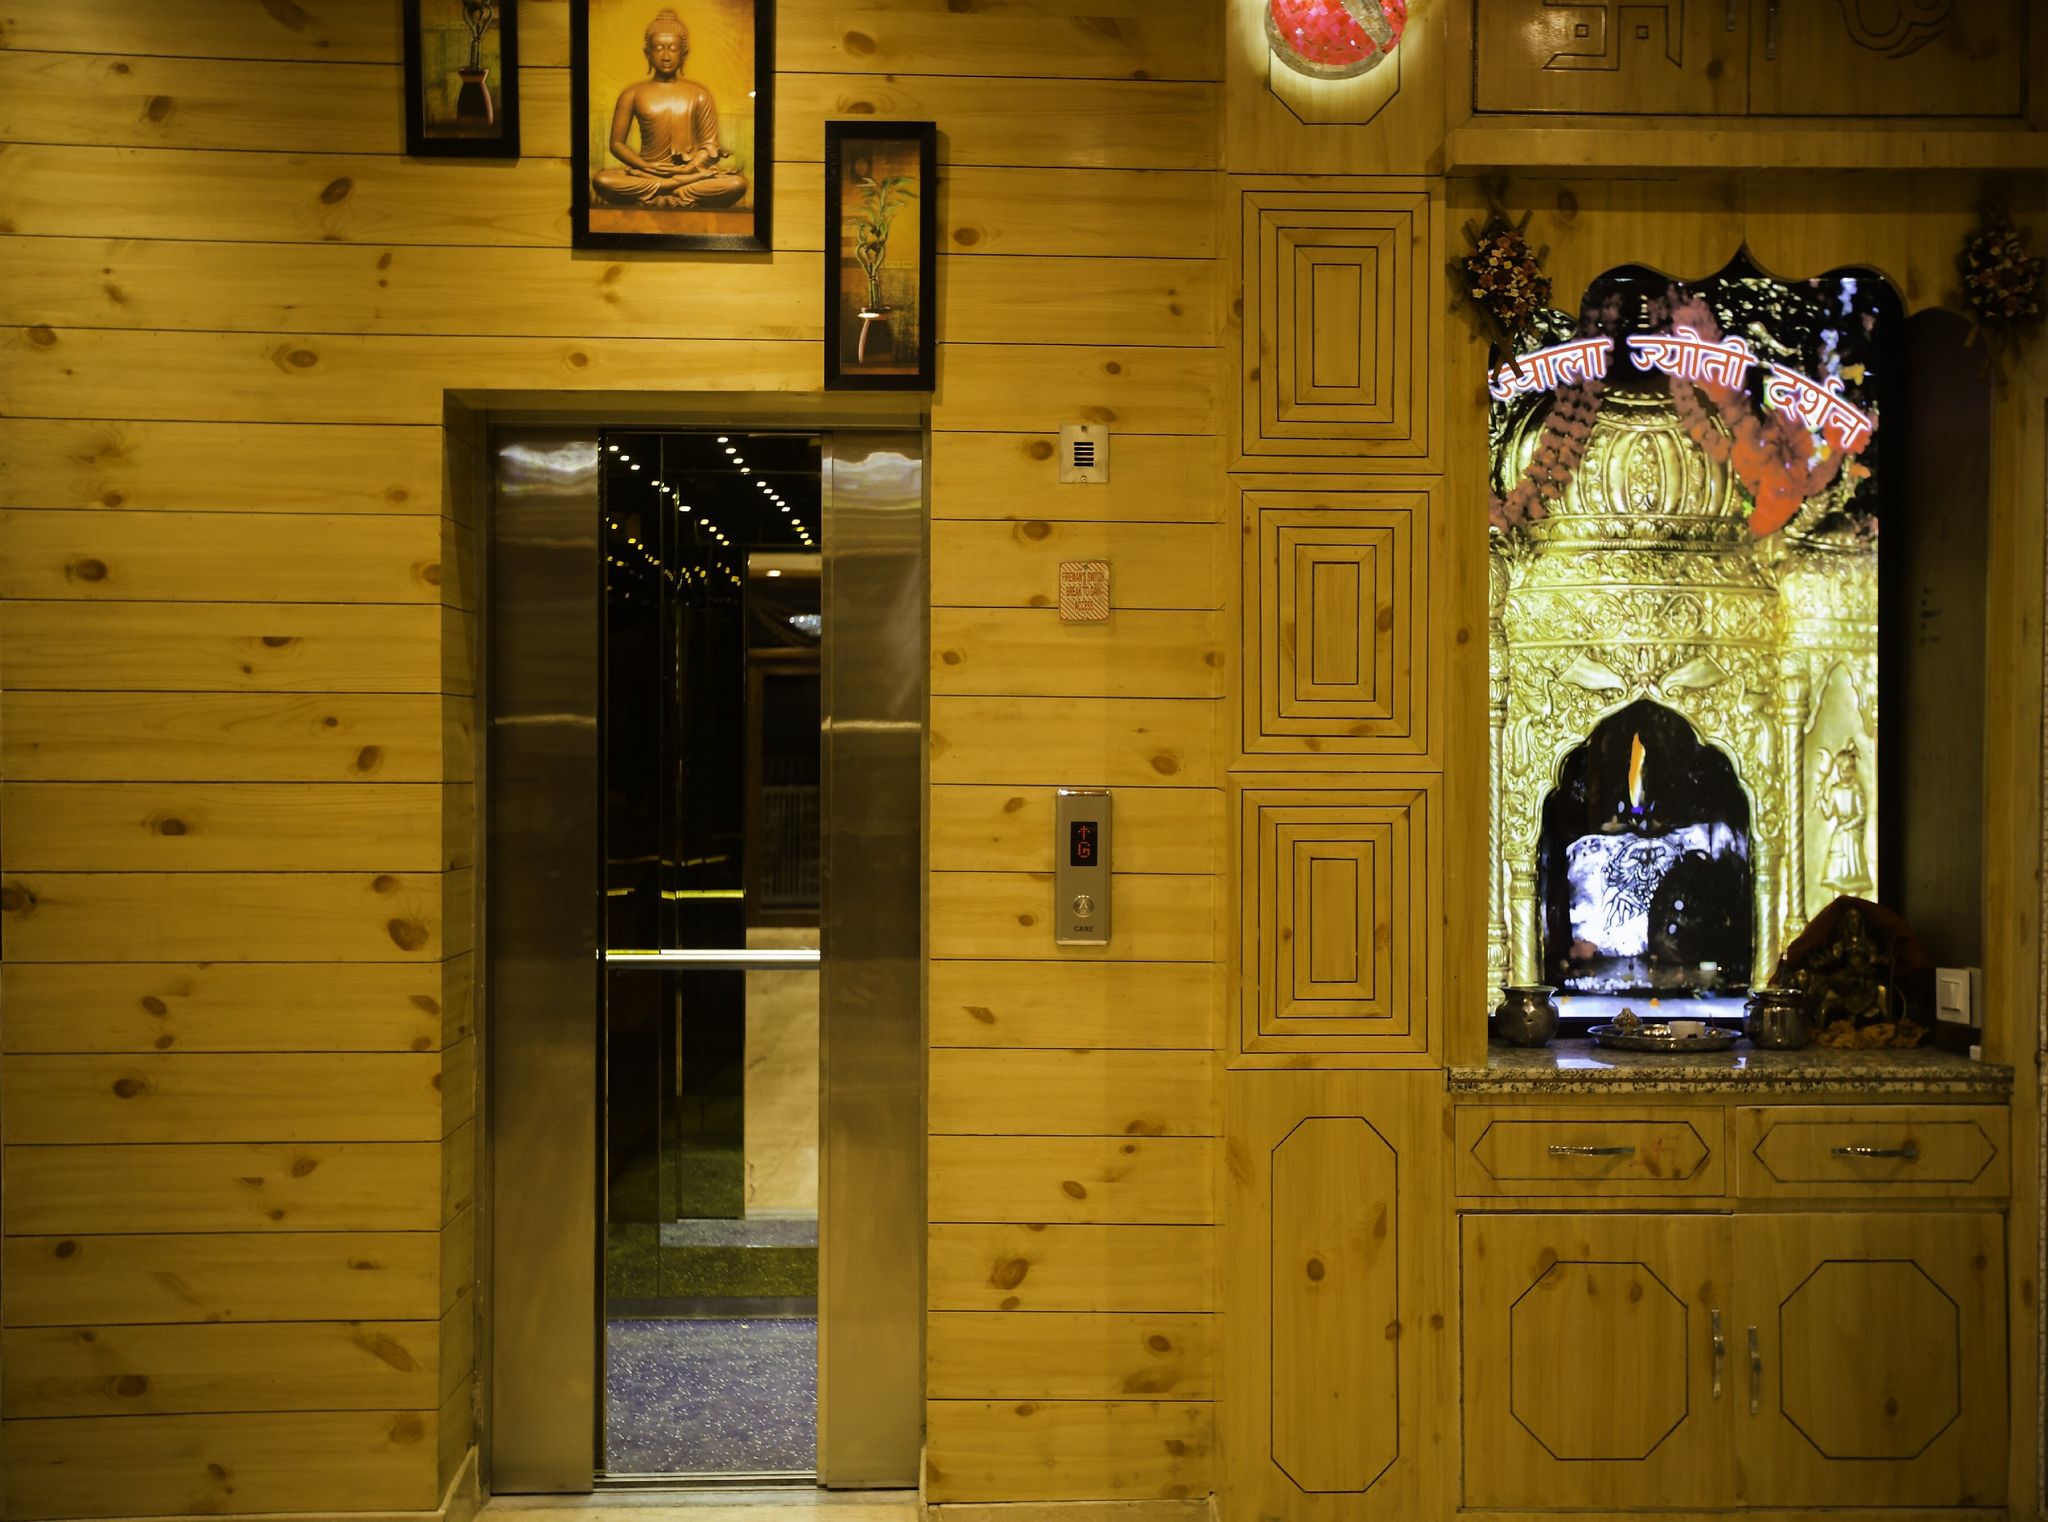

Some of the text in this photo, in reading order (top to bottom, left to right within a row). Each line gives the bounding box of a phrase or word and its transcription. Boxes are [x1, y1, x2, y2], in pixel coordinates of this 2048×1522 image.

[1628, 328, 1757, 388] ज्योती
[1768, 363, 1870, 447] दर्शन
[1077, 841, 1090, 858] G
